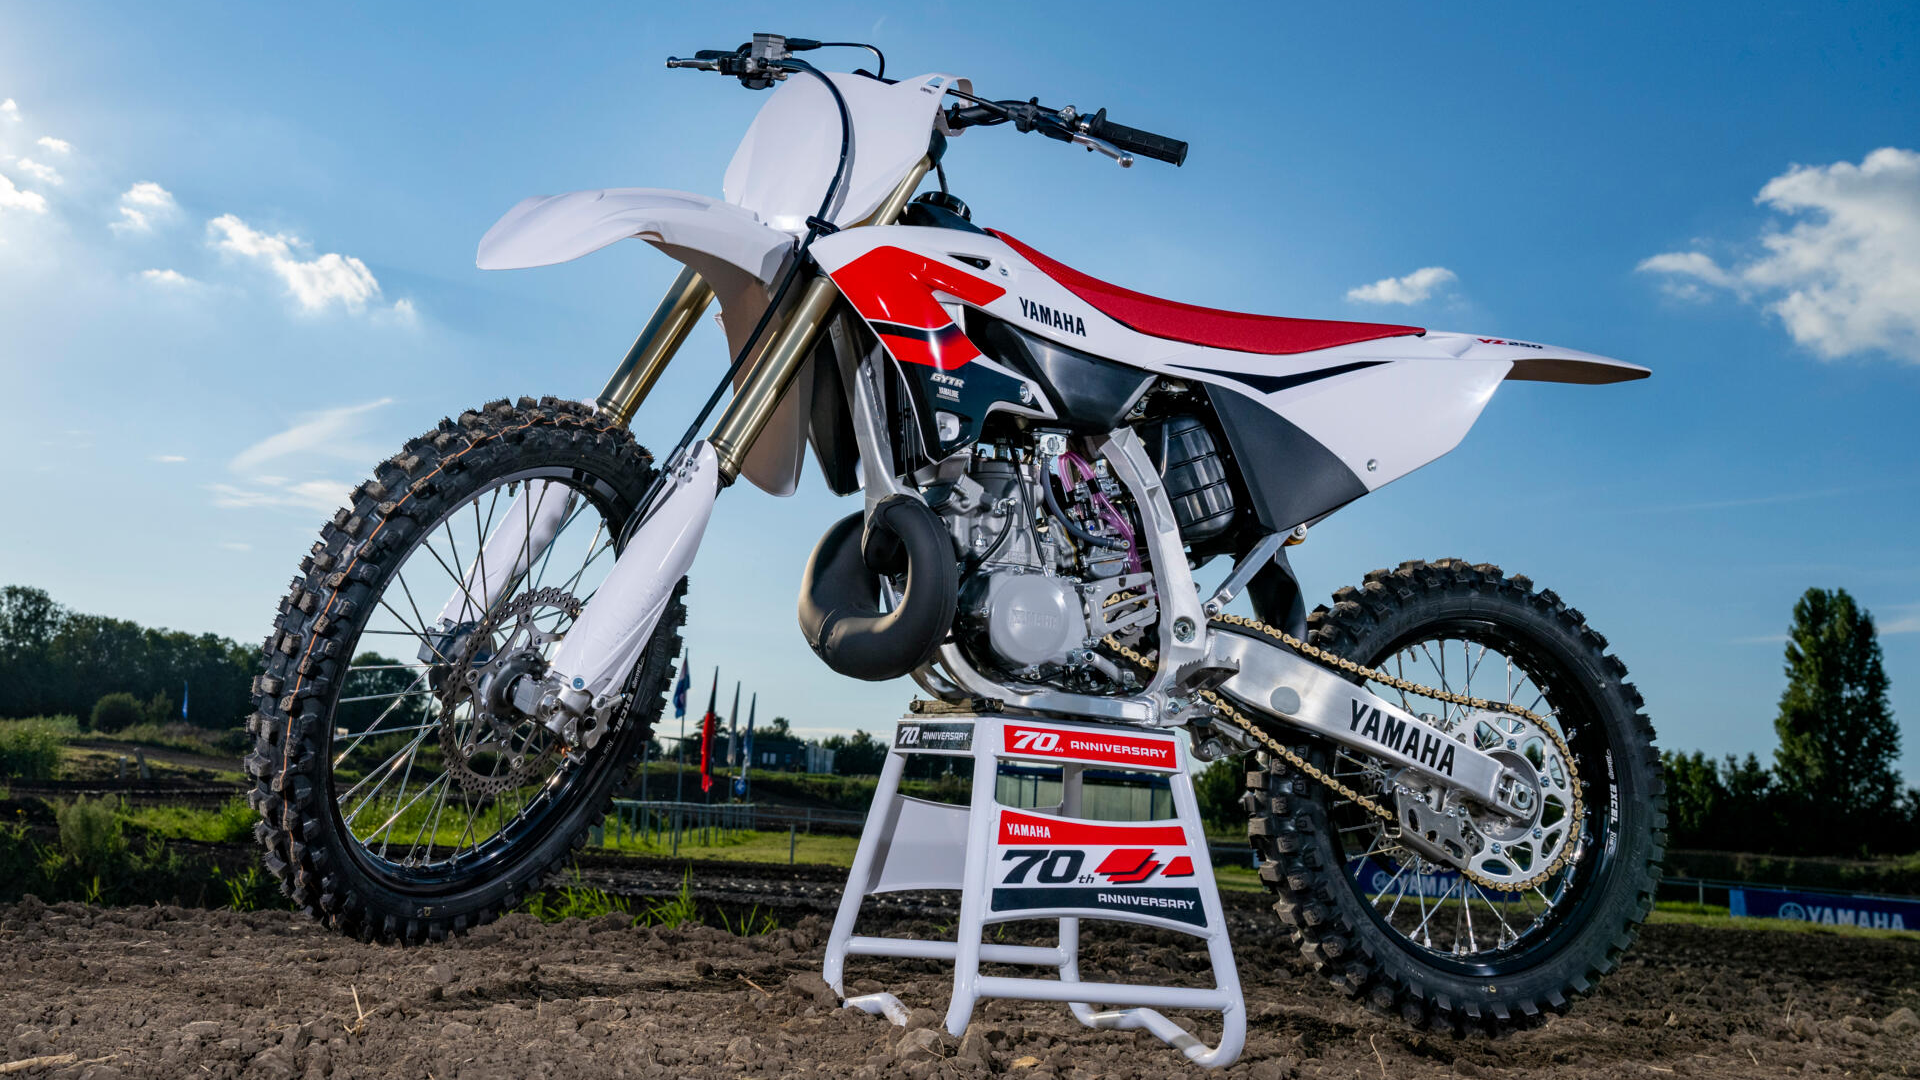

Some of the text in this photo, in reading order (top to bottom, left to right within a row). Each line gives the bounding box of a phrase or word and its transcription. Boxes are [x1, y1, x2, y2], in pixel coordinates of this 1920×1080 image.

[1019, 296, 1086, 337] YAMAHA
[930, 372, 965, 388] GYTR
[922, 731, 969, 741] ANNIVERSARY
[1013, 730, 1167, 758] 70th ANNIVERSARY
[1350, 699, 1455, 777] YAMAHA
[1610, 783, 1618, 824] EXCEL
[1007, 823, 1051, 838] YAMAHA
[1002, 850, 1095, 884] 70th
[1098, 893, 1195, 910] ANNIVERSARY
[1806, 905, 1905, 930] YAMAHA
